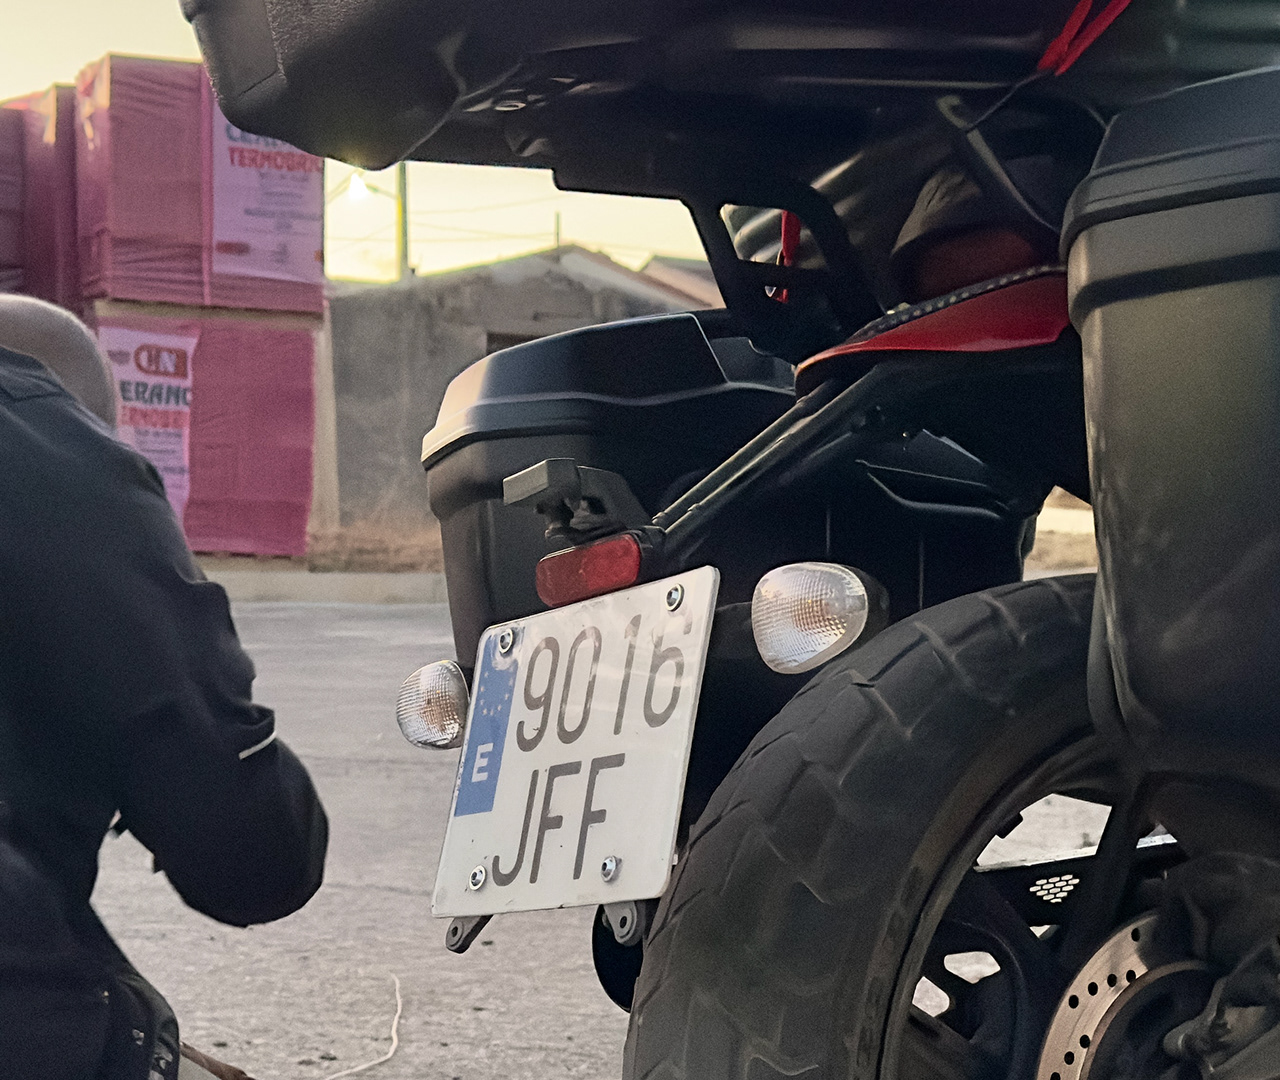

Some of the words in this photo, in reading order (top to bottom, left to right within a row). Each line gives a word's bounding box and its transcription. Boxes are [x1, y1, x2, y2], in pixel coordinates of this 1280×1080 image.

[516, 614, 694, 752] 9016
[471, 743, 495, 782] E
[492, 753, 626, 886] JFF
